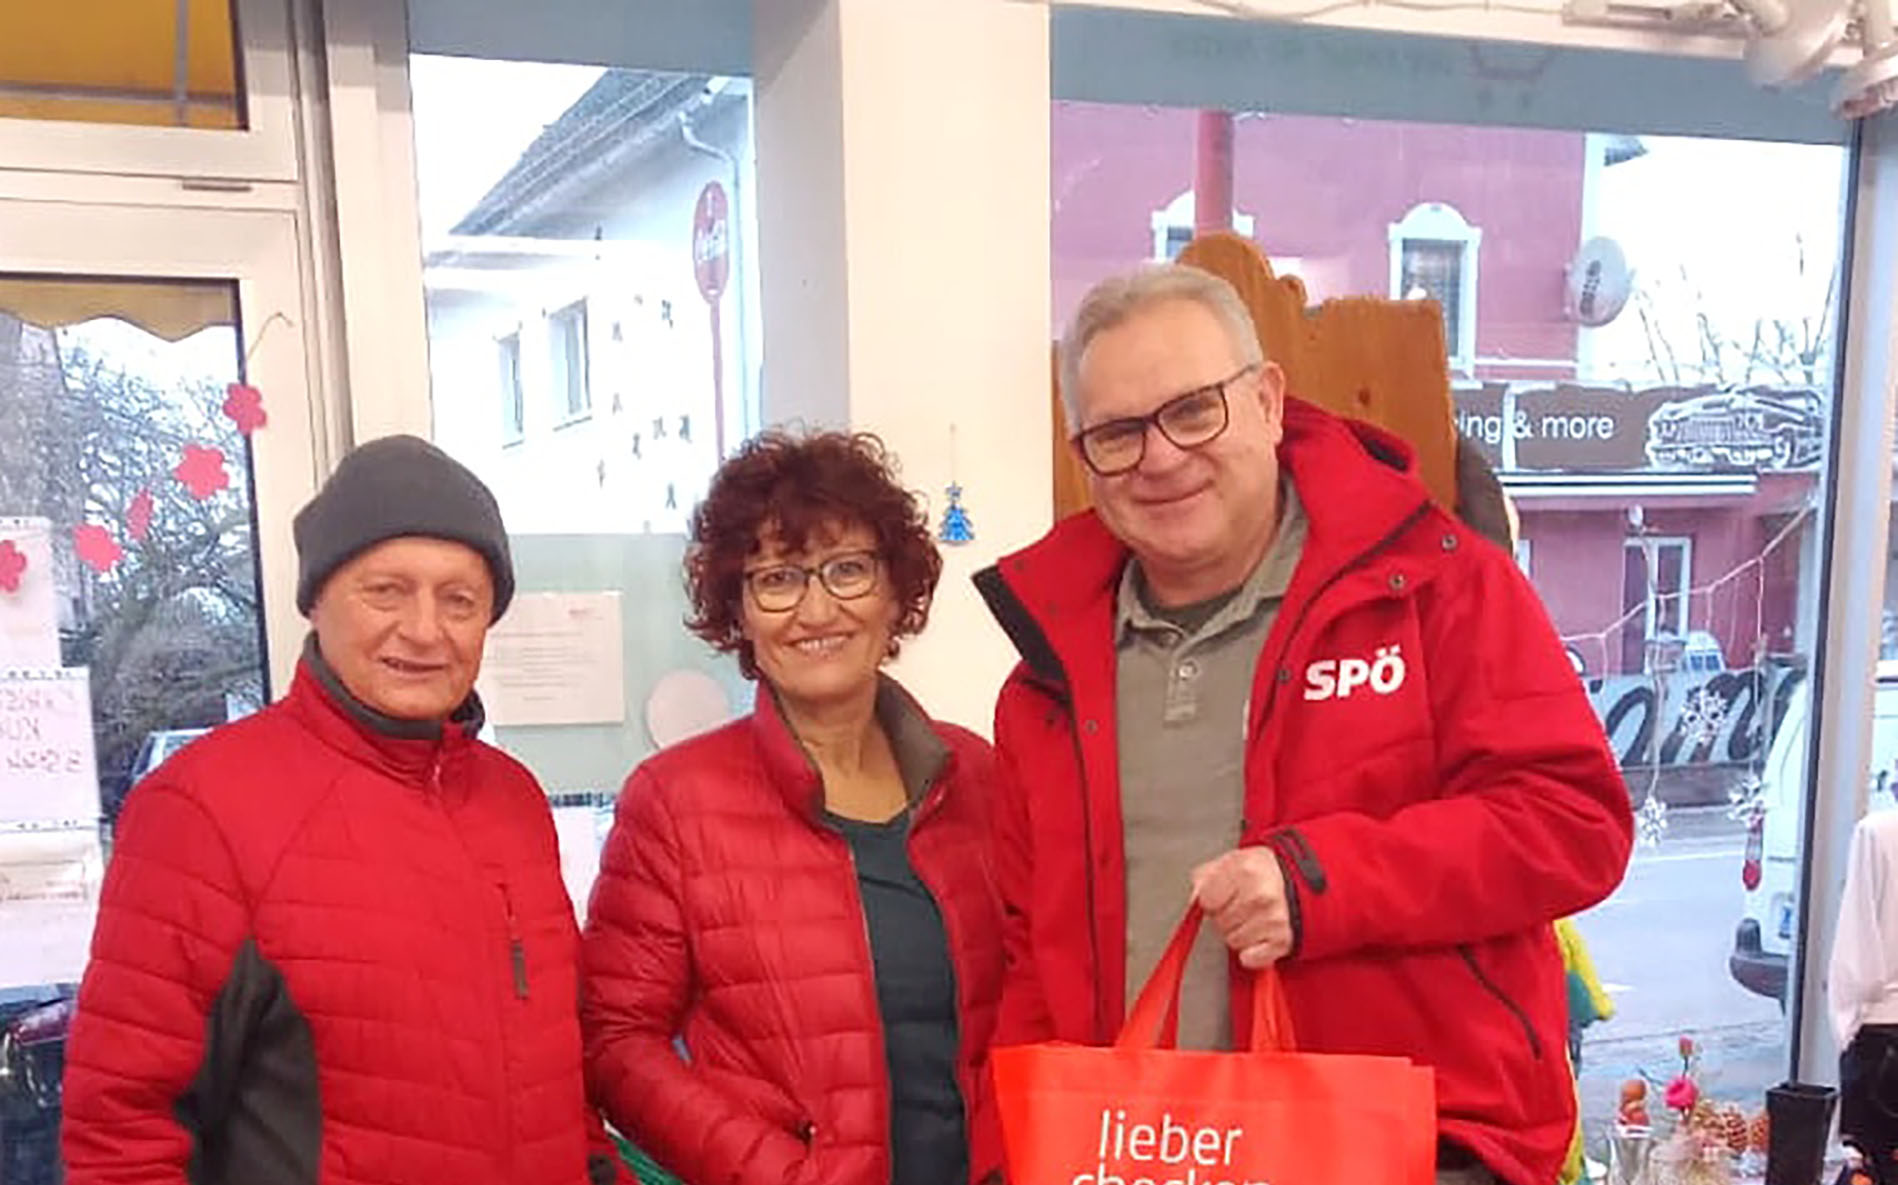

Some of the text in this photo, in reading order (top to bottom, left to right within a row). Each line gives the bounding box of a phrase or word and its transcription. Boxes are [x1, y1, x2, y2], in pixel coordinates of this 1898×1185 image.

[1453, 409, 1614, 444] ing & more
[1304, 644, 1405, 701] SPÖ
[1099, 1109, 1243, 1166] lieber
